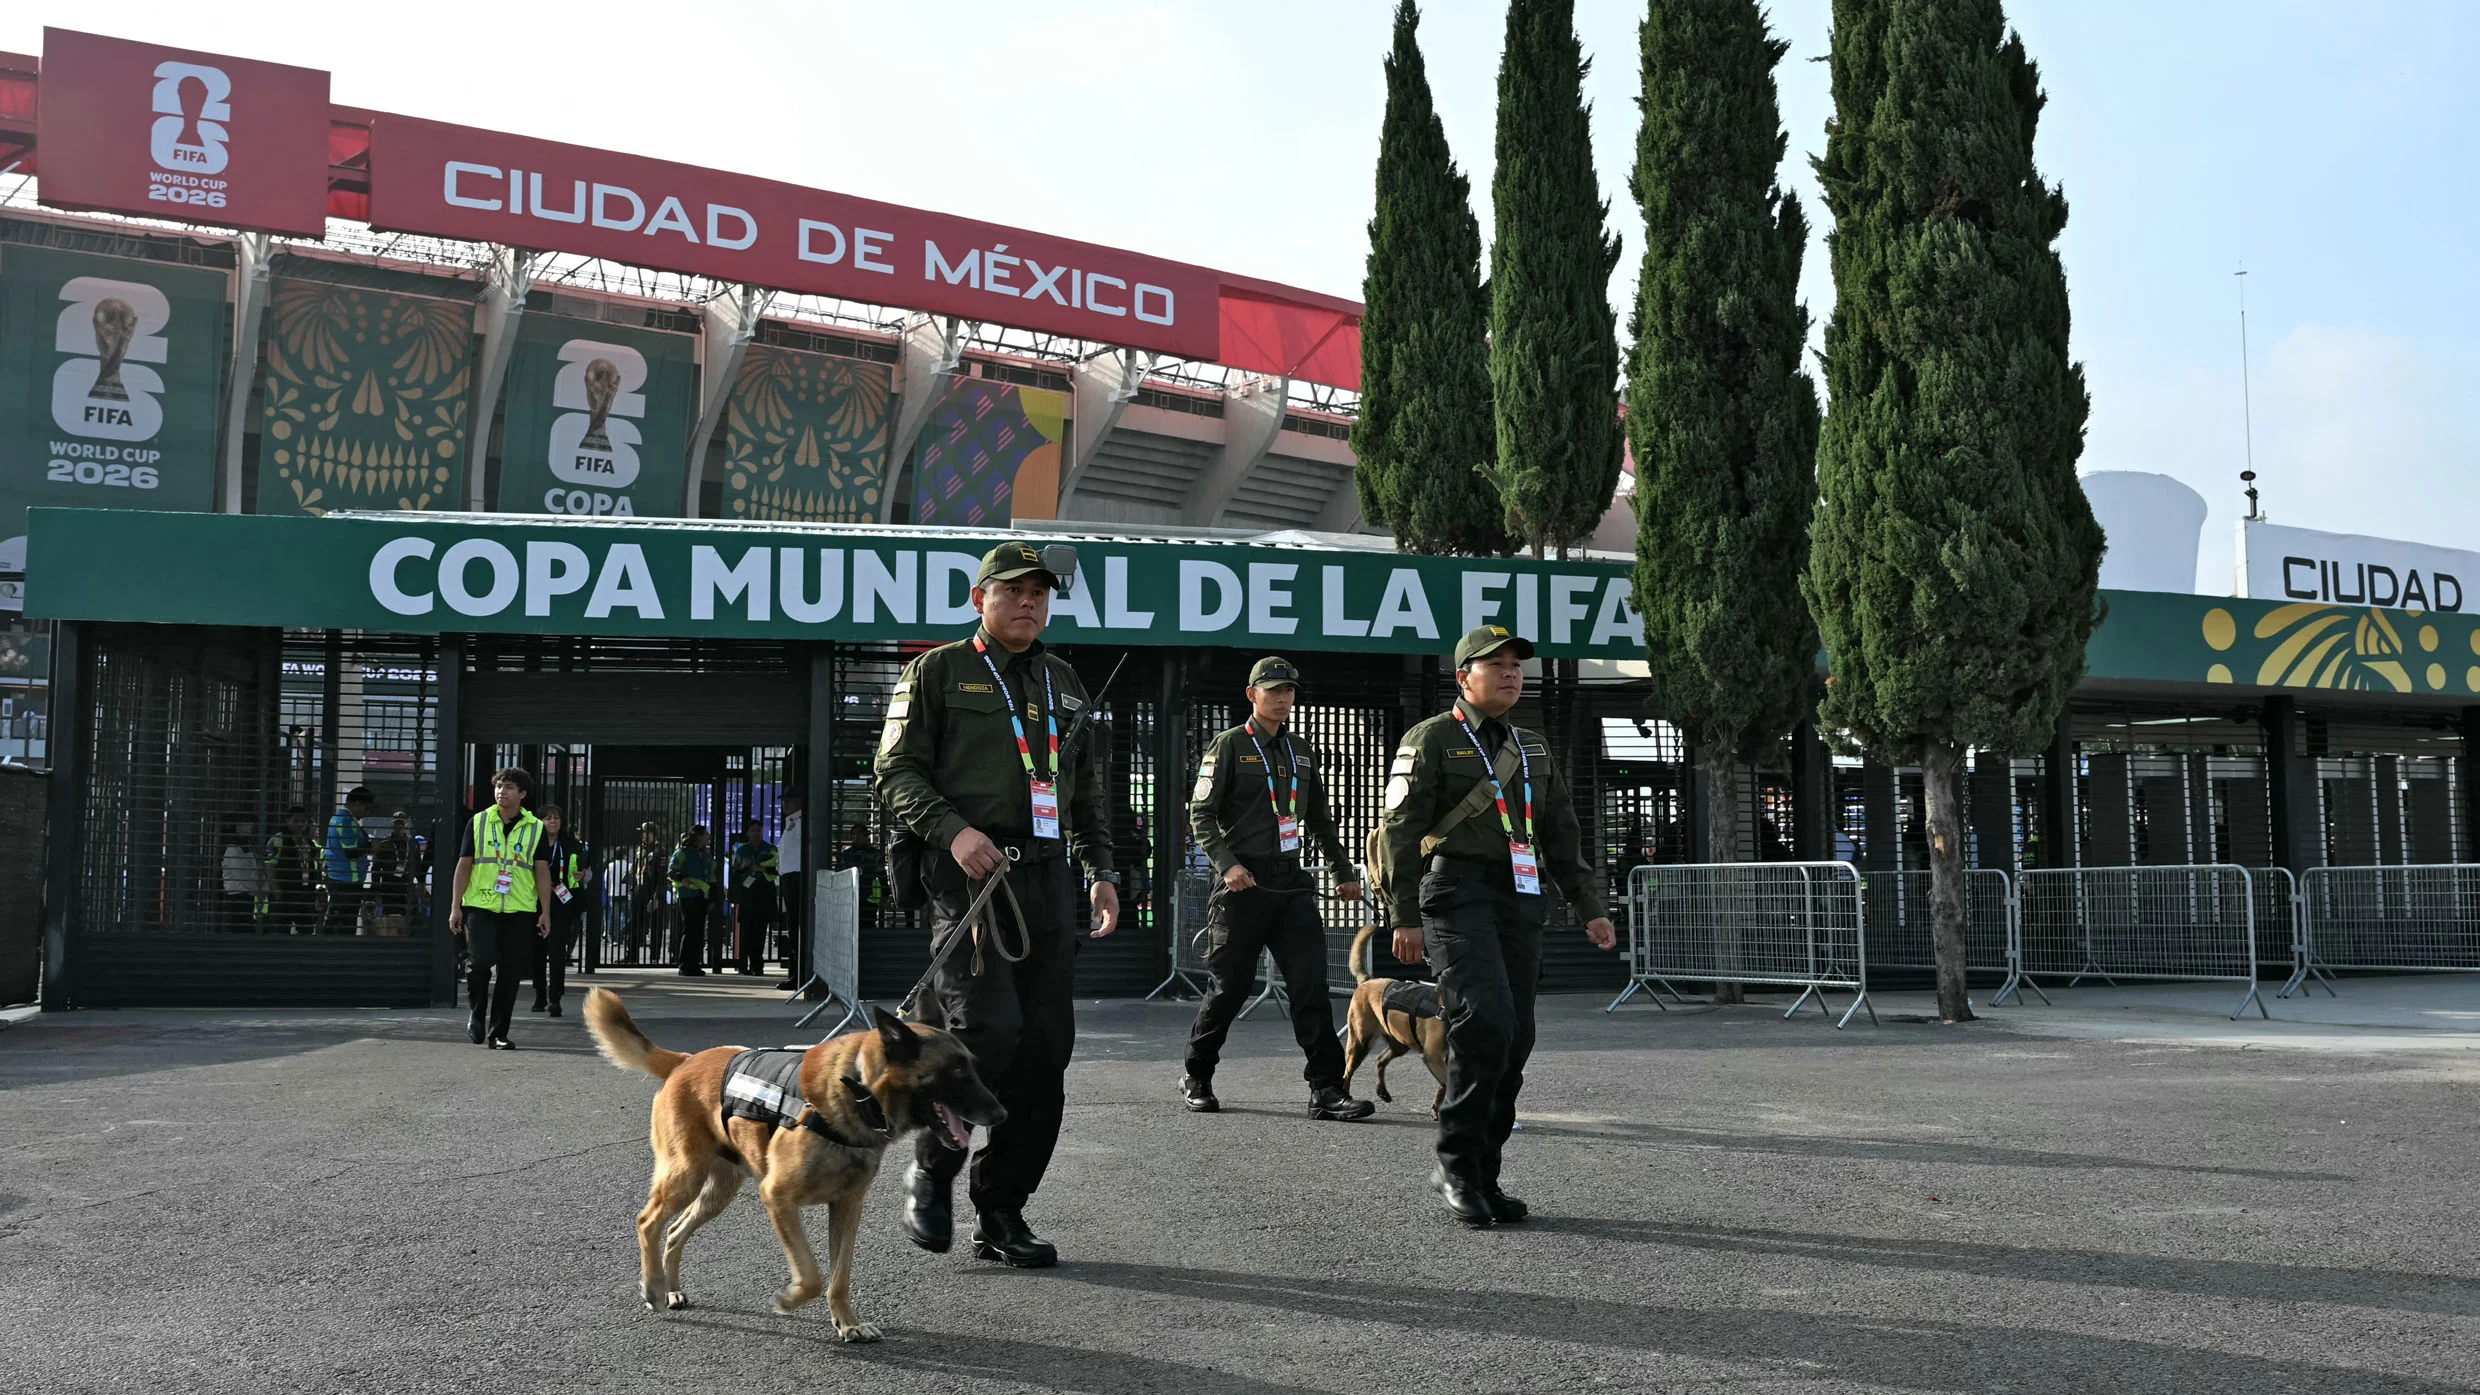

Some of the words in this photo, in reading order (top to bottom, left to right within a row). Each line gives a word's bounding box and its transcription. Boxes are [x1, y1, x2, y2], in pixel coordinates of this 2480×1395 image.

[173, 148, 207, 164] FIFA
[150, 172, 198, 187] WORLD
[201, 178, 228, 190] CUP
[148, 184, 227, 208] 2026
[444, 160, 758, 251] CIUDAD
[798, 218, 895, 275] DE
[924, 239, 1174, 326] MÉXICO
[84, 406, 133, 426] FIFA
[49, 441, 119, 460] WORLD
[122, 448, 161, 463] CUP
[47, 459, 159, 489] 2026
[575, 455, 615, 474] FIFA
[544, 488, 635, 517] COPA
[368, 536, 666, 620] COPA
[690, 546, 1155, 629] MUNDAL
[1179, 560, 1300, 635] DE
[1322, 565, 1441, 639] LA
[1461, 571, 1647, 647] FIFA
[2283, 556, 2463, 613] CIUDAD
[282, 662, 301, 674] FA
